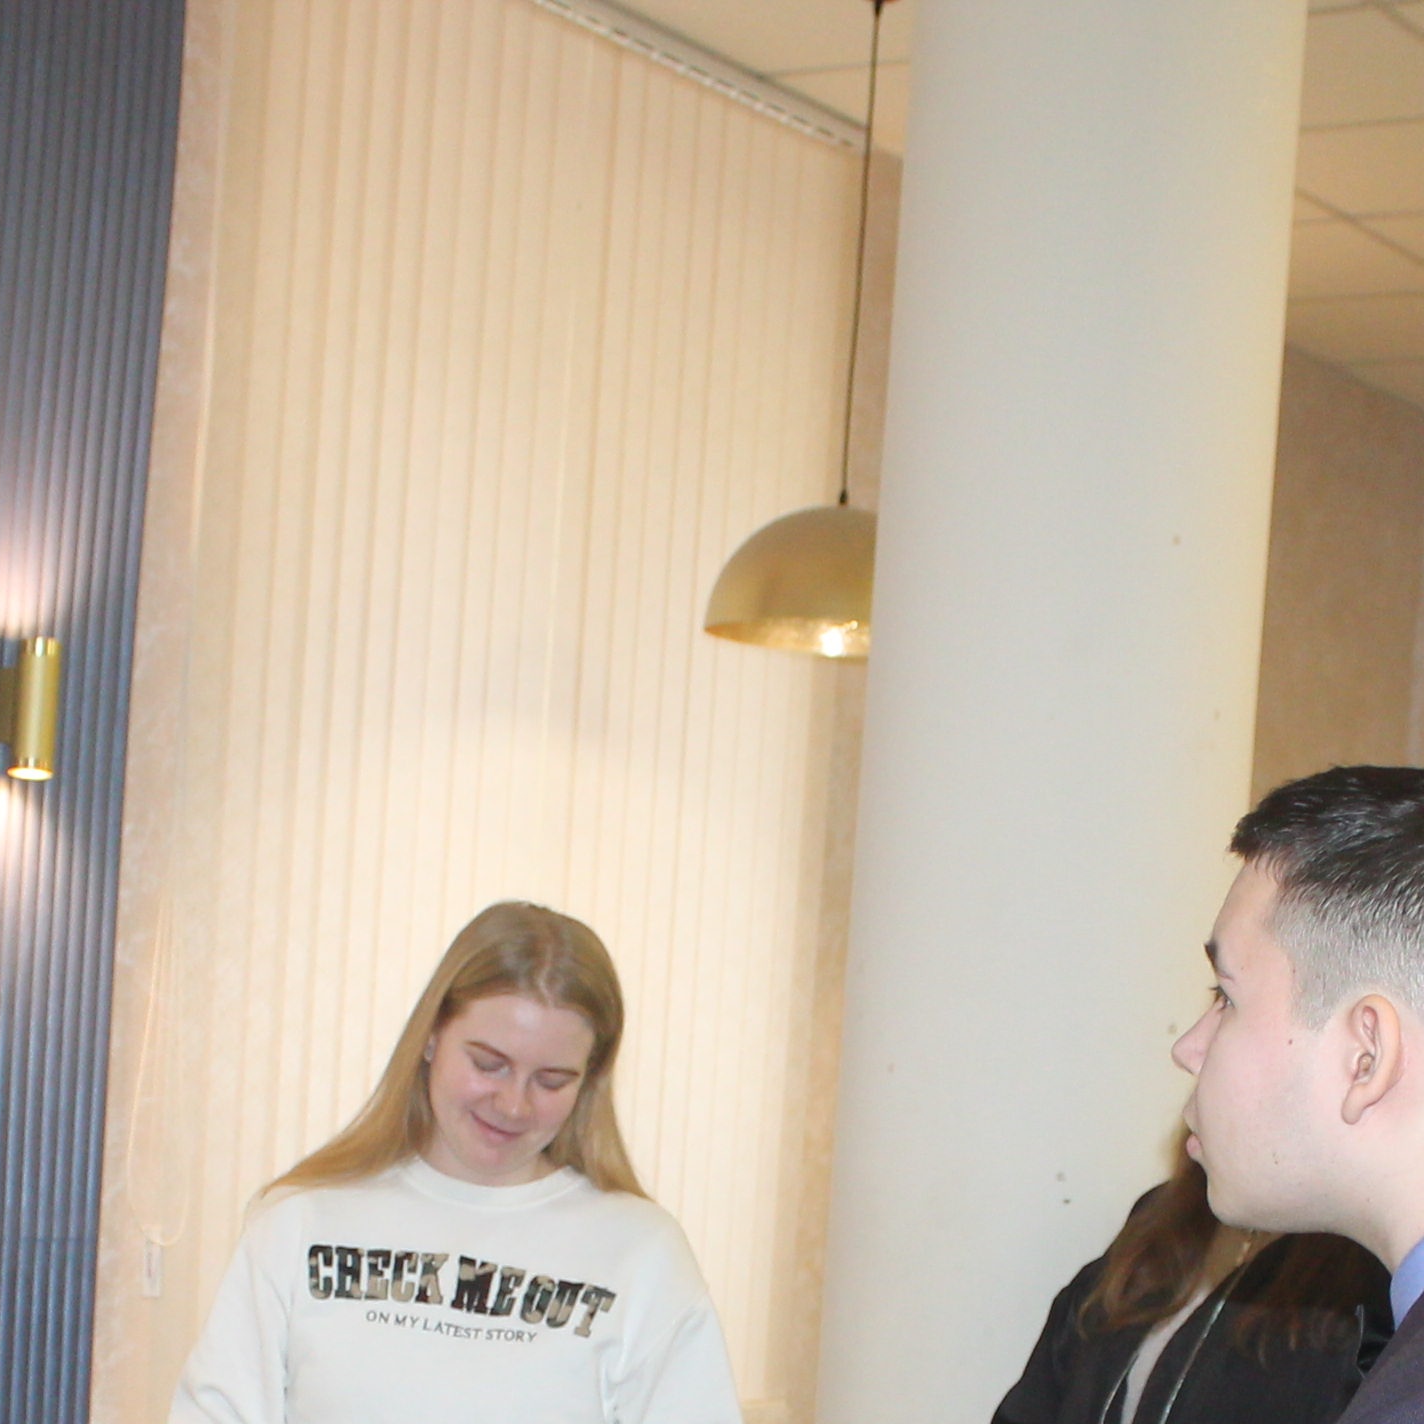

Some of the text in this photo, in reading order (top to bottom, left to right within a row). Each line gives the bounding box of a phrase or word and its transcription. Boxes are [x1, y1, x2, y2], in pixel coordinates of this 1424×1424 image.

[308, 1244, 450, 1304] CHECK
[365, 1309, 538, 1344] ON MY LATEST STORY
